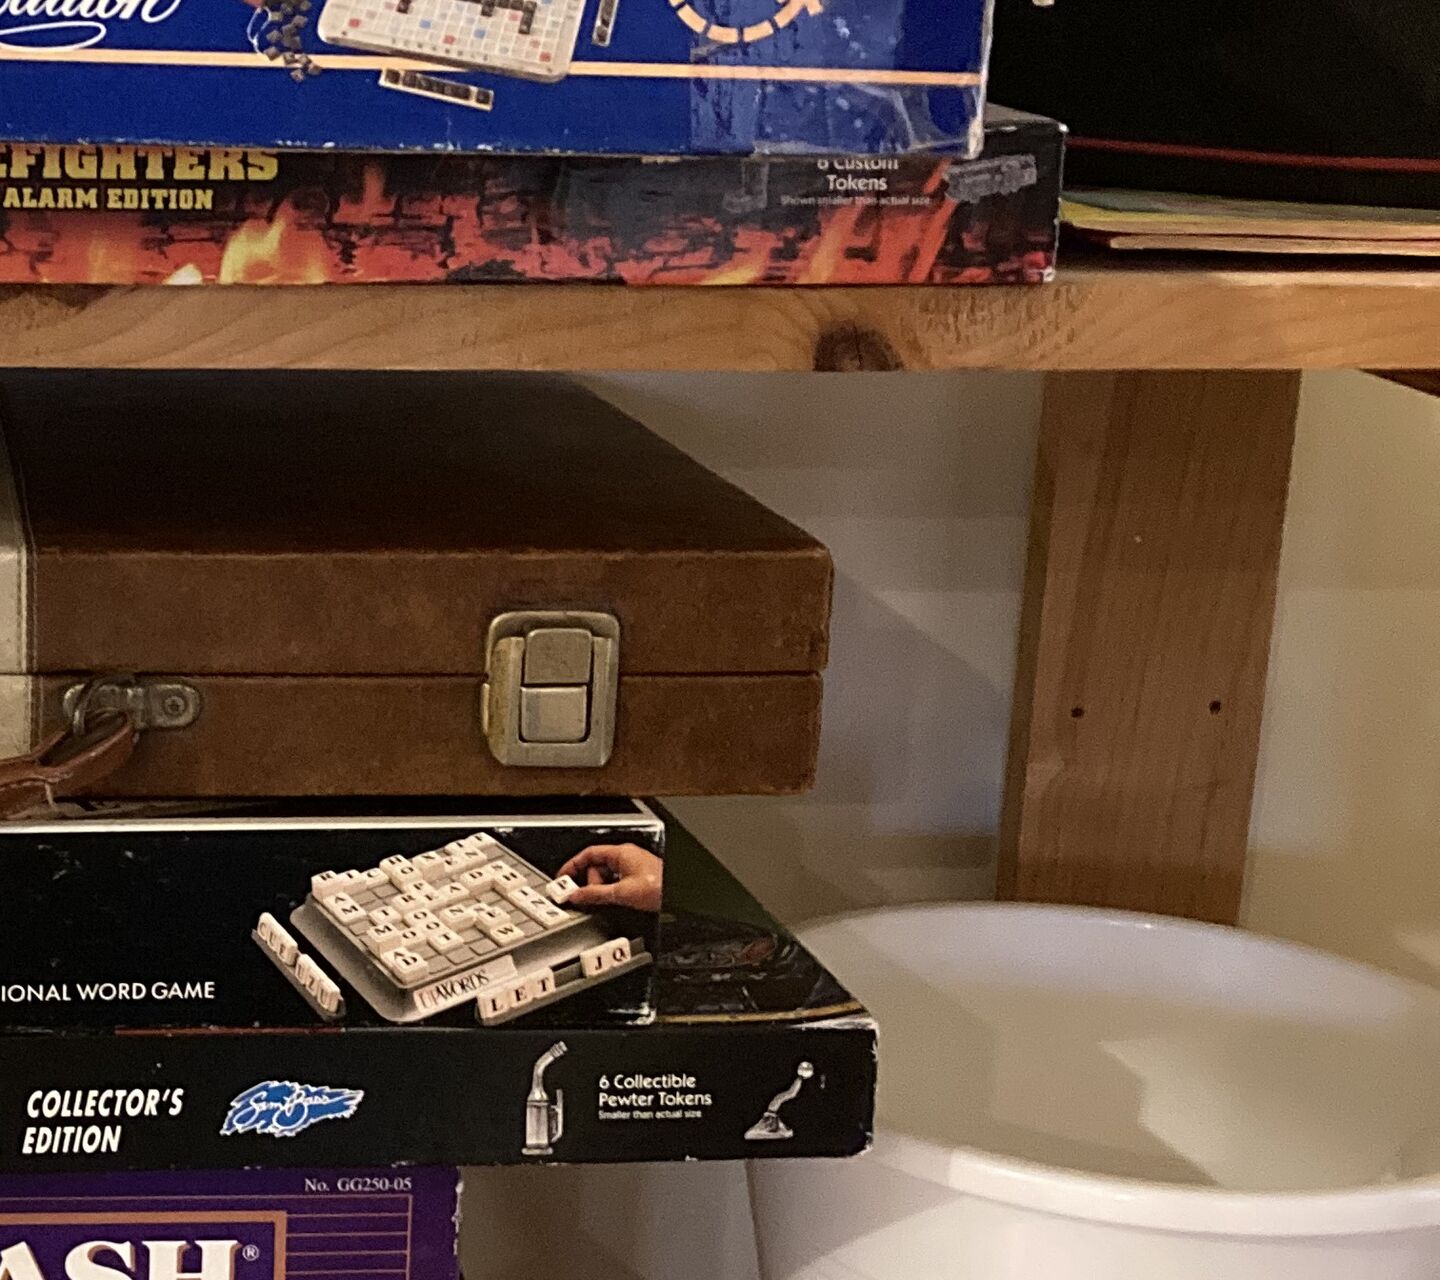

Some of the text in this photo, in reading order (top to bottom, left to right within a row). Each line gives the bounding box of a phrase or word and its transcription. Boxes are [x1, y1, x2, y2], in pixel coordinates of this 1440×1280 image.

[826, 174, 888, 191] Tokens
[3, 188, 98, 209] ALARM
[107, 188, 213, 210] EDITION
[76, 982, 149, 1003] WORD
[152, 980, 216, 1002] GAME
[599, 1073, 697, 1089] 6 Collectible
[26, 1088, 186, 1119] COLLECTOR'S
[599, 1091, 712, 1107] Pewter Tokens
[598, 1110, 630, 1119] Smaller
[633, 1110, 654, 1119] than
[684, 1109, 702, 1118] size
[22, 1124, 122, 1155] EDITION
[304, 1176, 412, 1192] No. GG250-05
